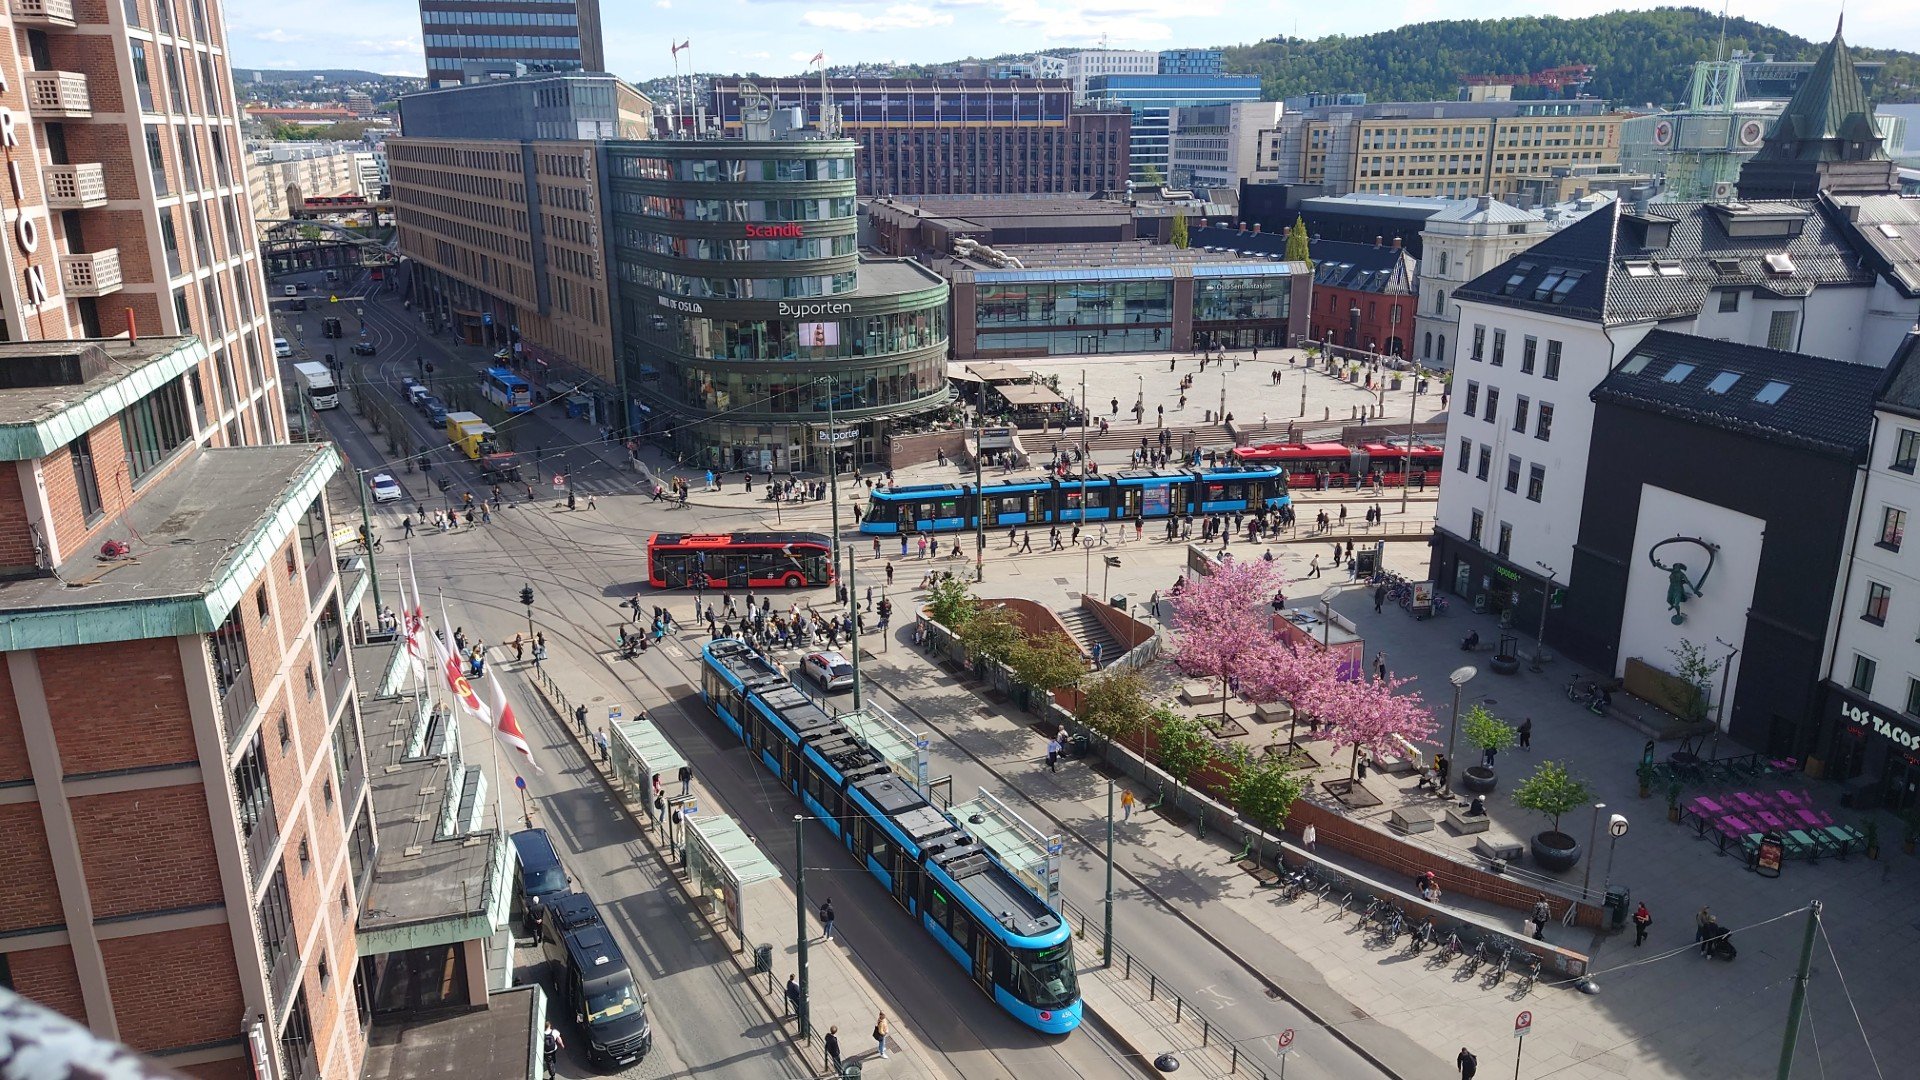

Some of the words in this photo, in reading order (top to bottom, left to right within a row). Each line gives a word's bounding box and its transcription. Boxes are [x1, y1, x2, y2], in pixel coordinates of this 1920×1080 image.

[745, 223, 804, 237] Scandic
[779, 302, 852, 318] Byporten
[1841, 701, 1870, 726] LOS
[1872, 716, 1920, 751] TACOS
